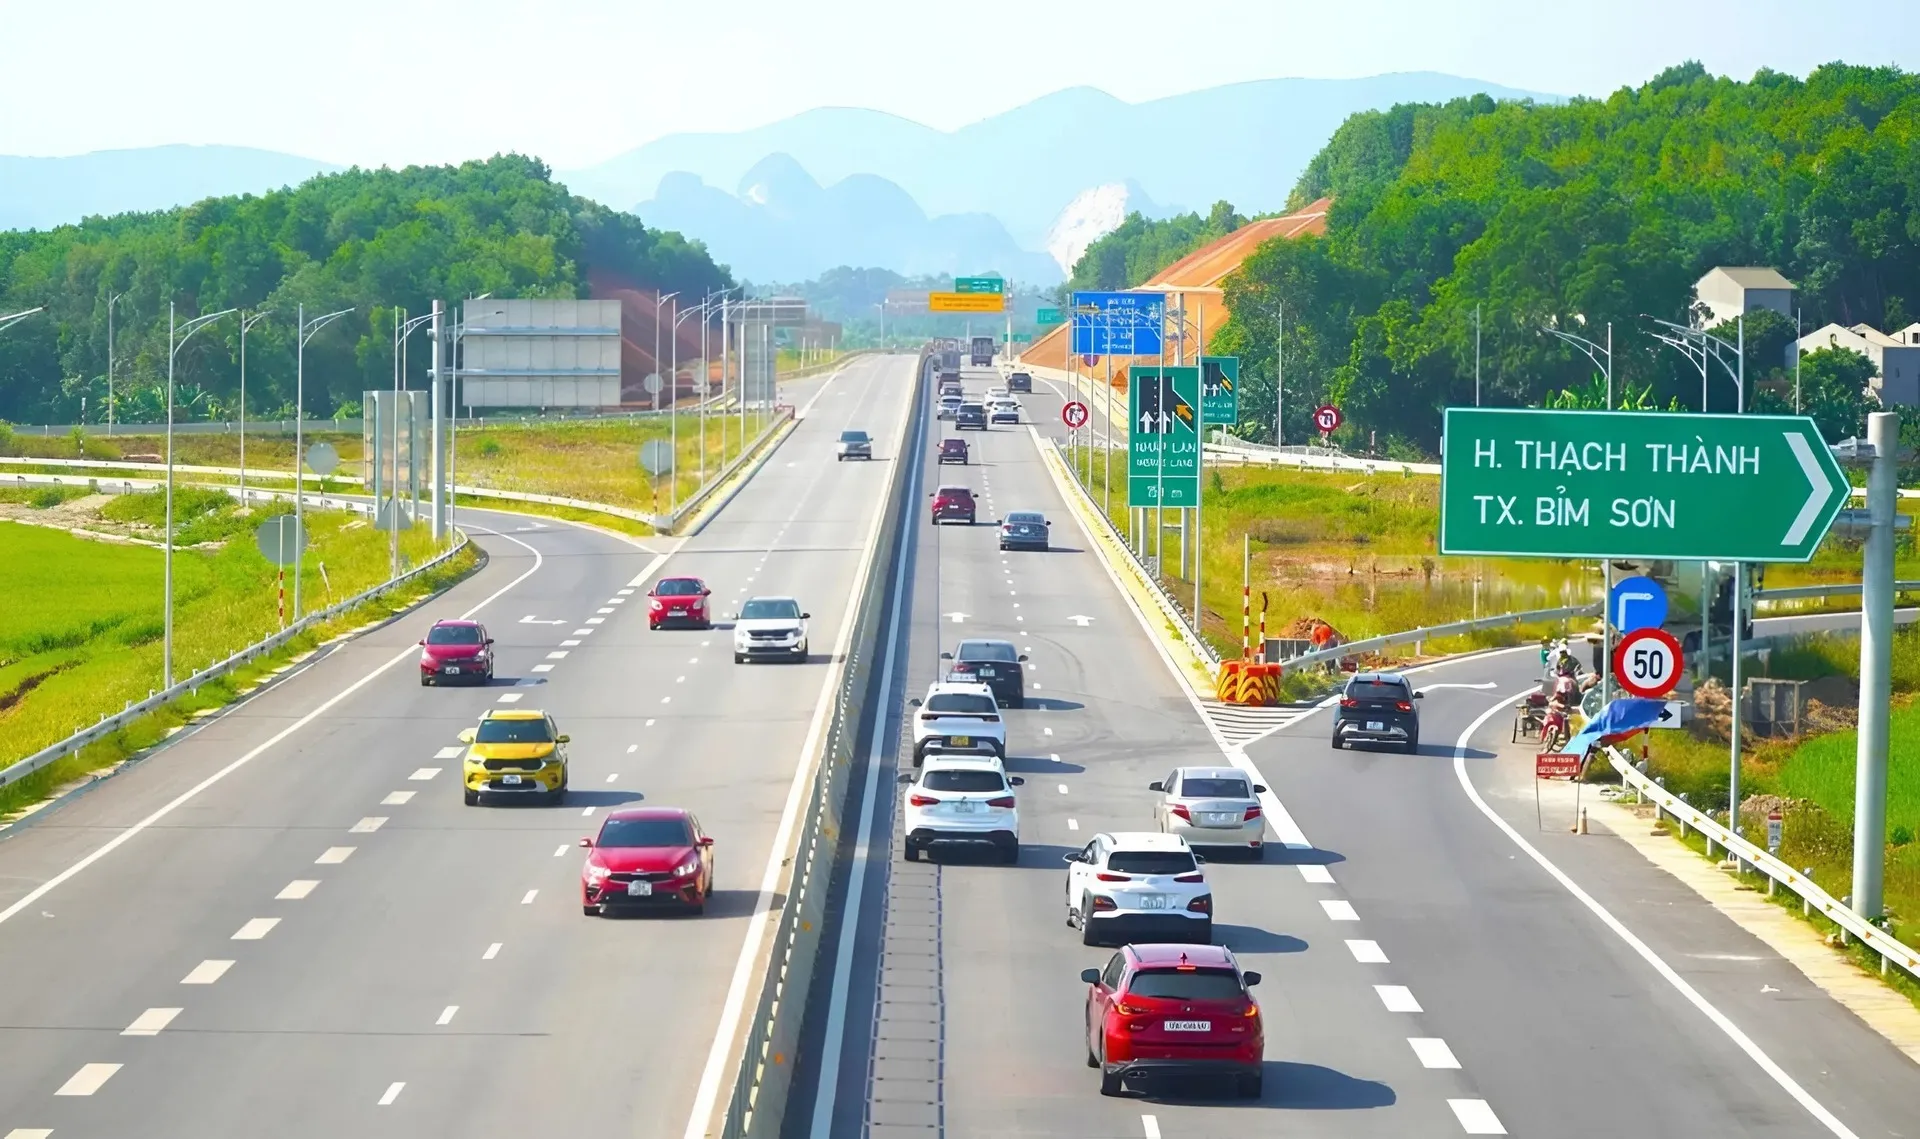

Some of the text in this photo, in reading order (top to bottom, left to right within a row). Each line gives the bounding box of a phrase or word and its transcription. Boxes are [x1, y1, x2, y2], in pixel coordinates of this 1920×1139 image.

[1474, 435, 1760, 476] H. THẠCH THÀNH
[1473, 485, 1676, 529] TX. BỈM SƠN
[1632, 649, 1664, 680] 50
